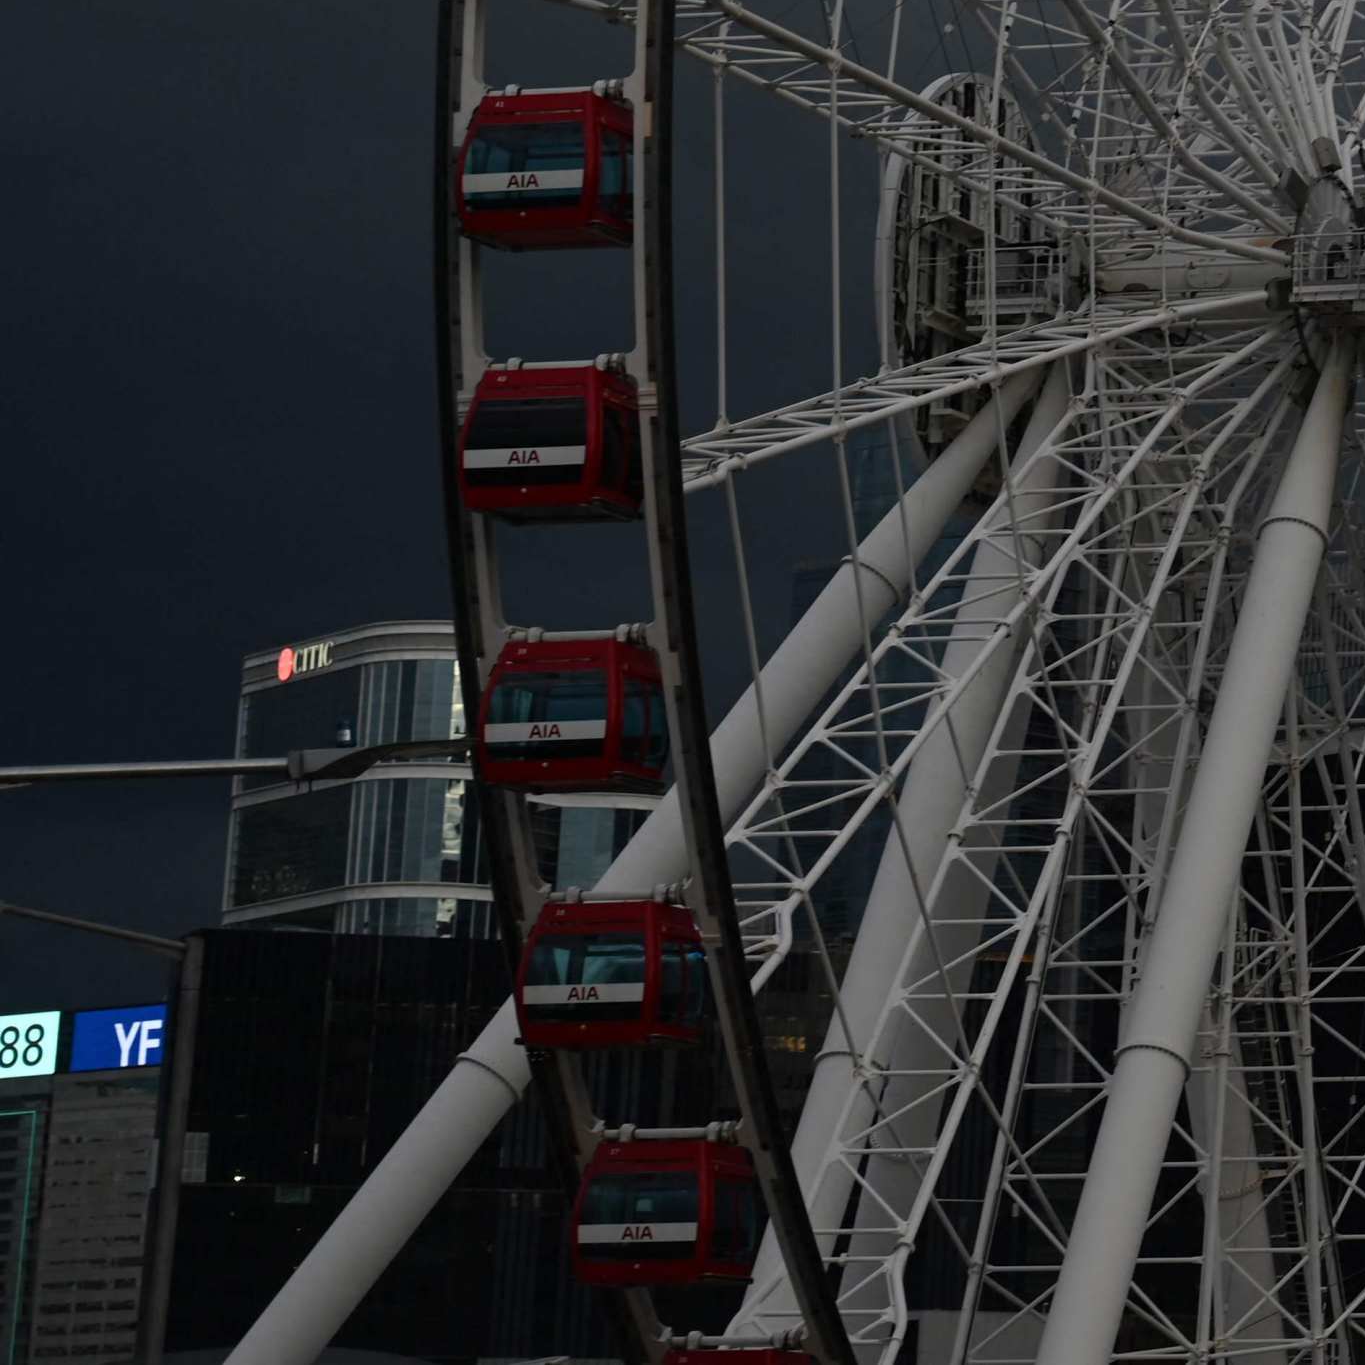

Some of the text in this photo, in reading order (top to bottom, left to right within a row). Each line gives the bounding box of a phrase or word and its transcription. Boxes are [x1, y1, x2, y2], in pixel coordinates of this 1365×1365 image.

[507, 175, 539, 189] AIA
[508, 451, 540, 464] AIA
[293, 641, 334, 674] CITIC
[530, 725, 561, 738] AIA
[568, 987, 599, 1000] AIA
[114, 1019, 163, 1067] YF
[622, 1226, 653, 1240] AIA
